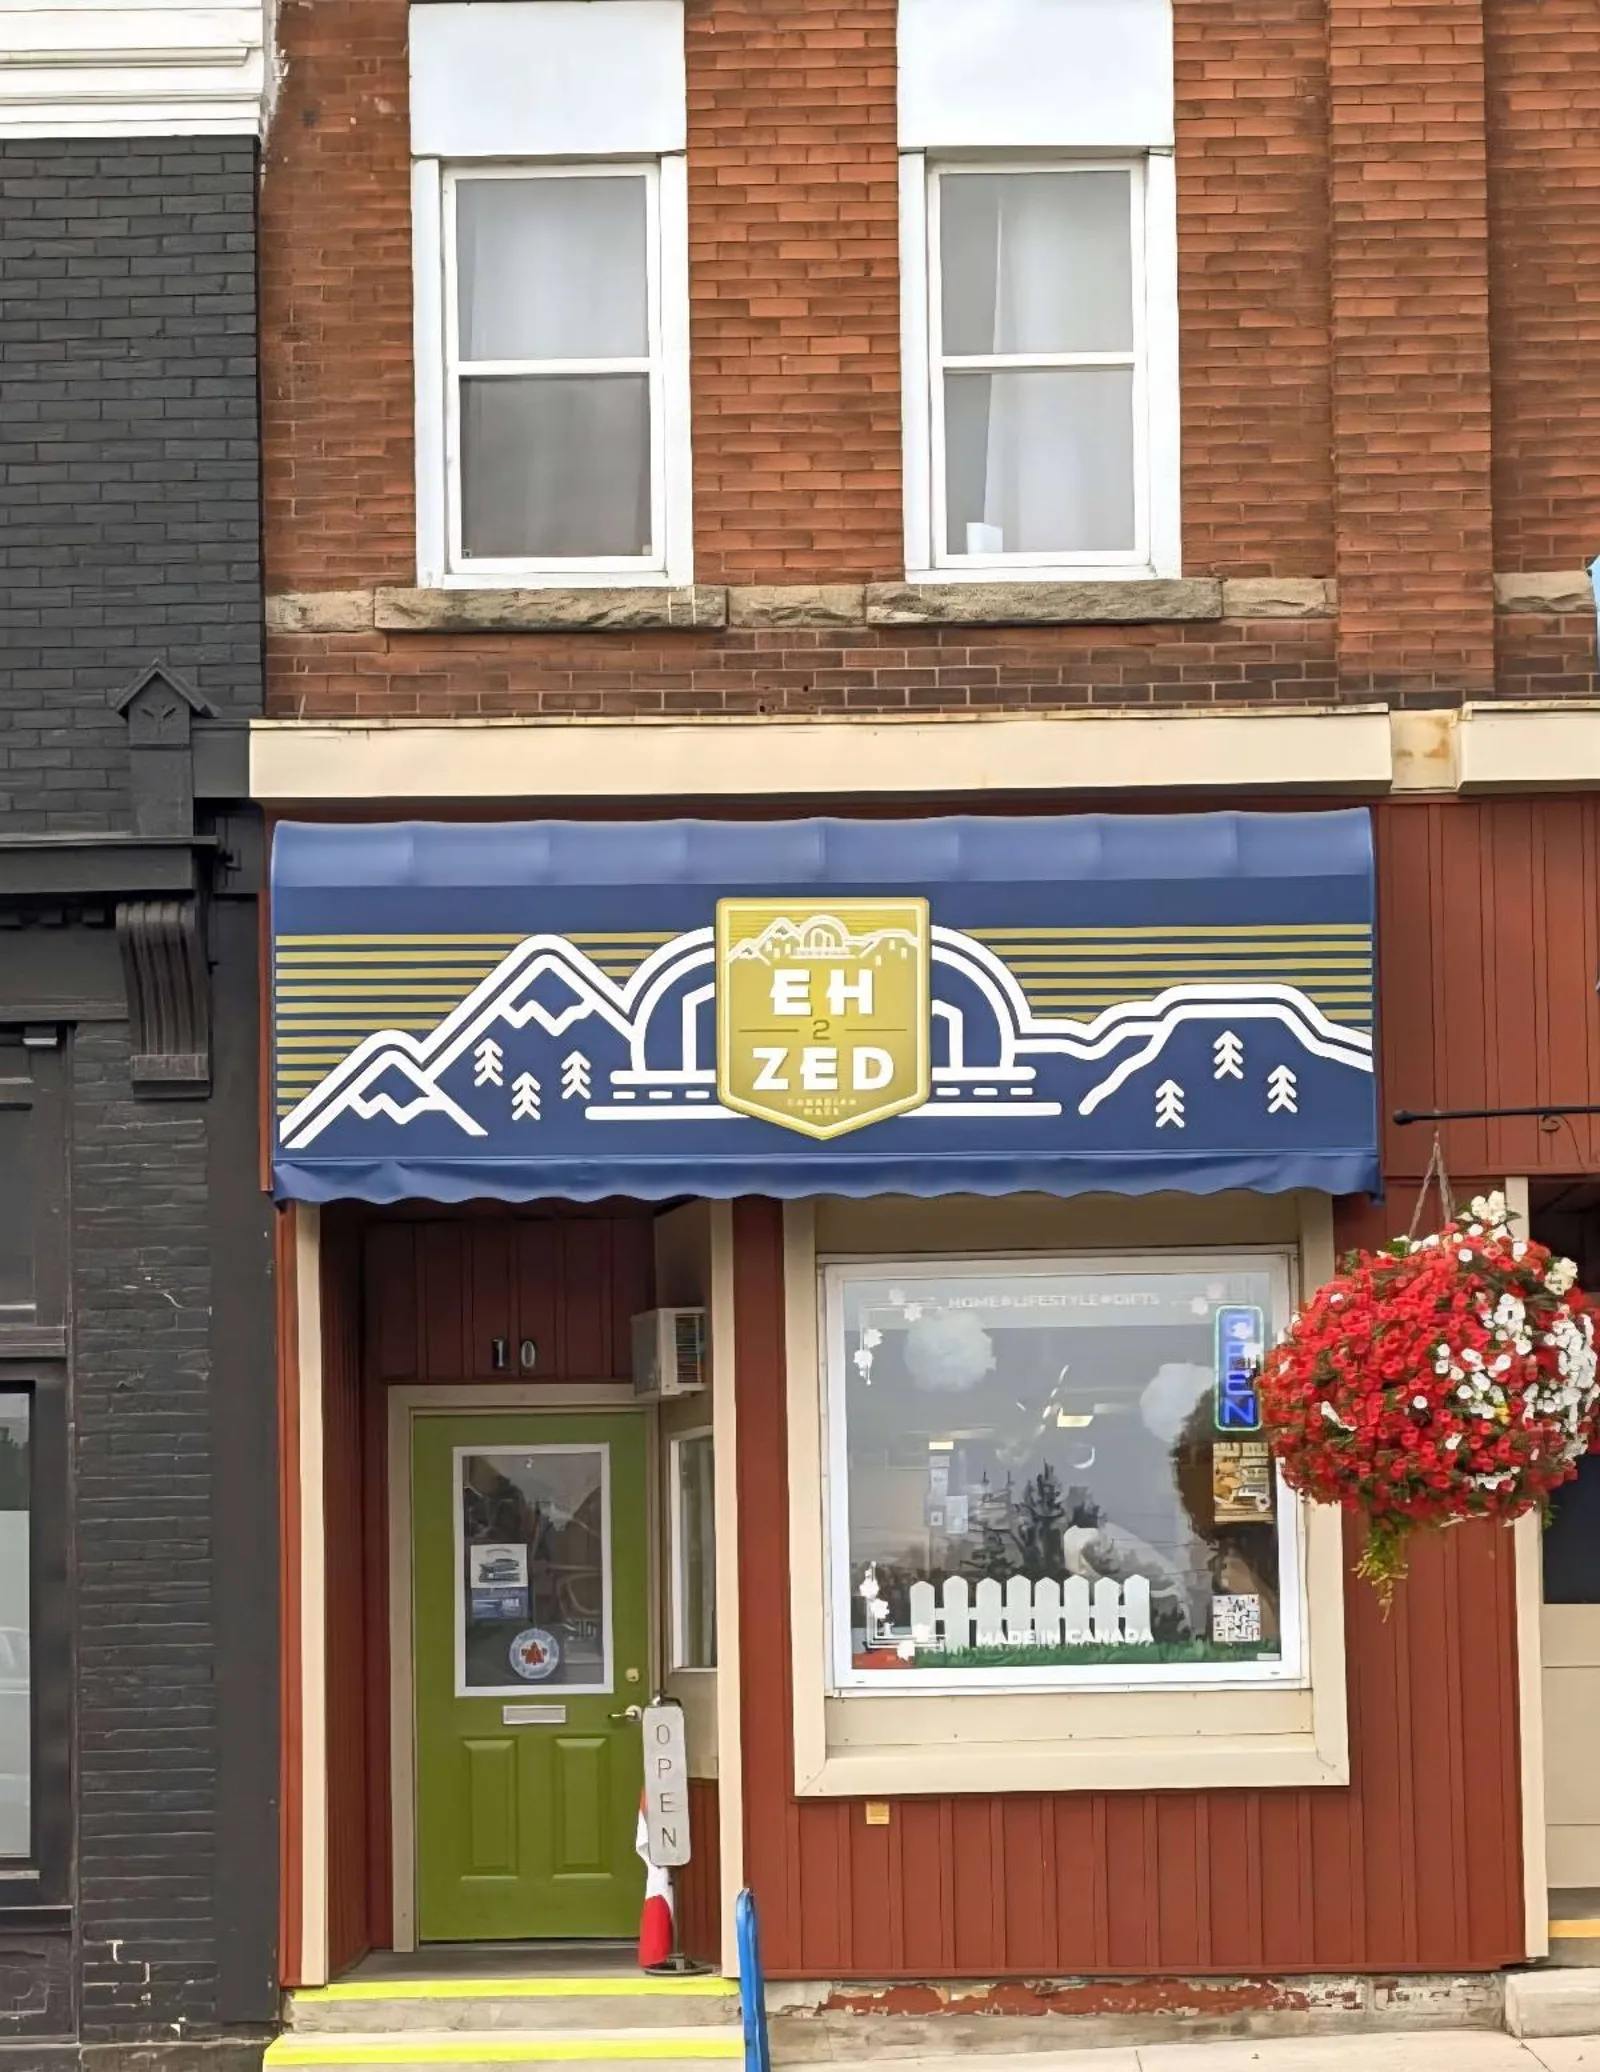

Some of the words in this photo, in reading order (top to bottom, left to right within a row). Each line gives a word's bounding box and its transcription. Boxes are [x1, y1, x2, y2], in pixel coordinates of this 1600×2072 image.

[770, 969, 873, 1016] EH
[812, 1019, 831, 1040] 2
[752, 1047, 894, 1091] ZED
[949, 1296, 1001, 1309] HOME
[1013, 1294, 1099, 1308] LIFESTYLE
[492, 1339, 536, 1368] 10
[977, 1629, 1037, 1645] MADE
[1040, 1629, 1061, 1645] IN
[1065, 1628, 1155, 1644] CANADA
[656, 1723, 678, 1848] OPEN
